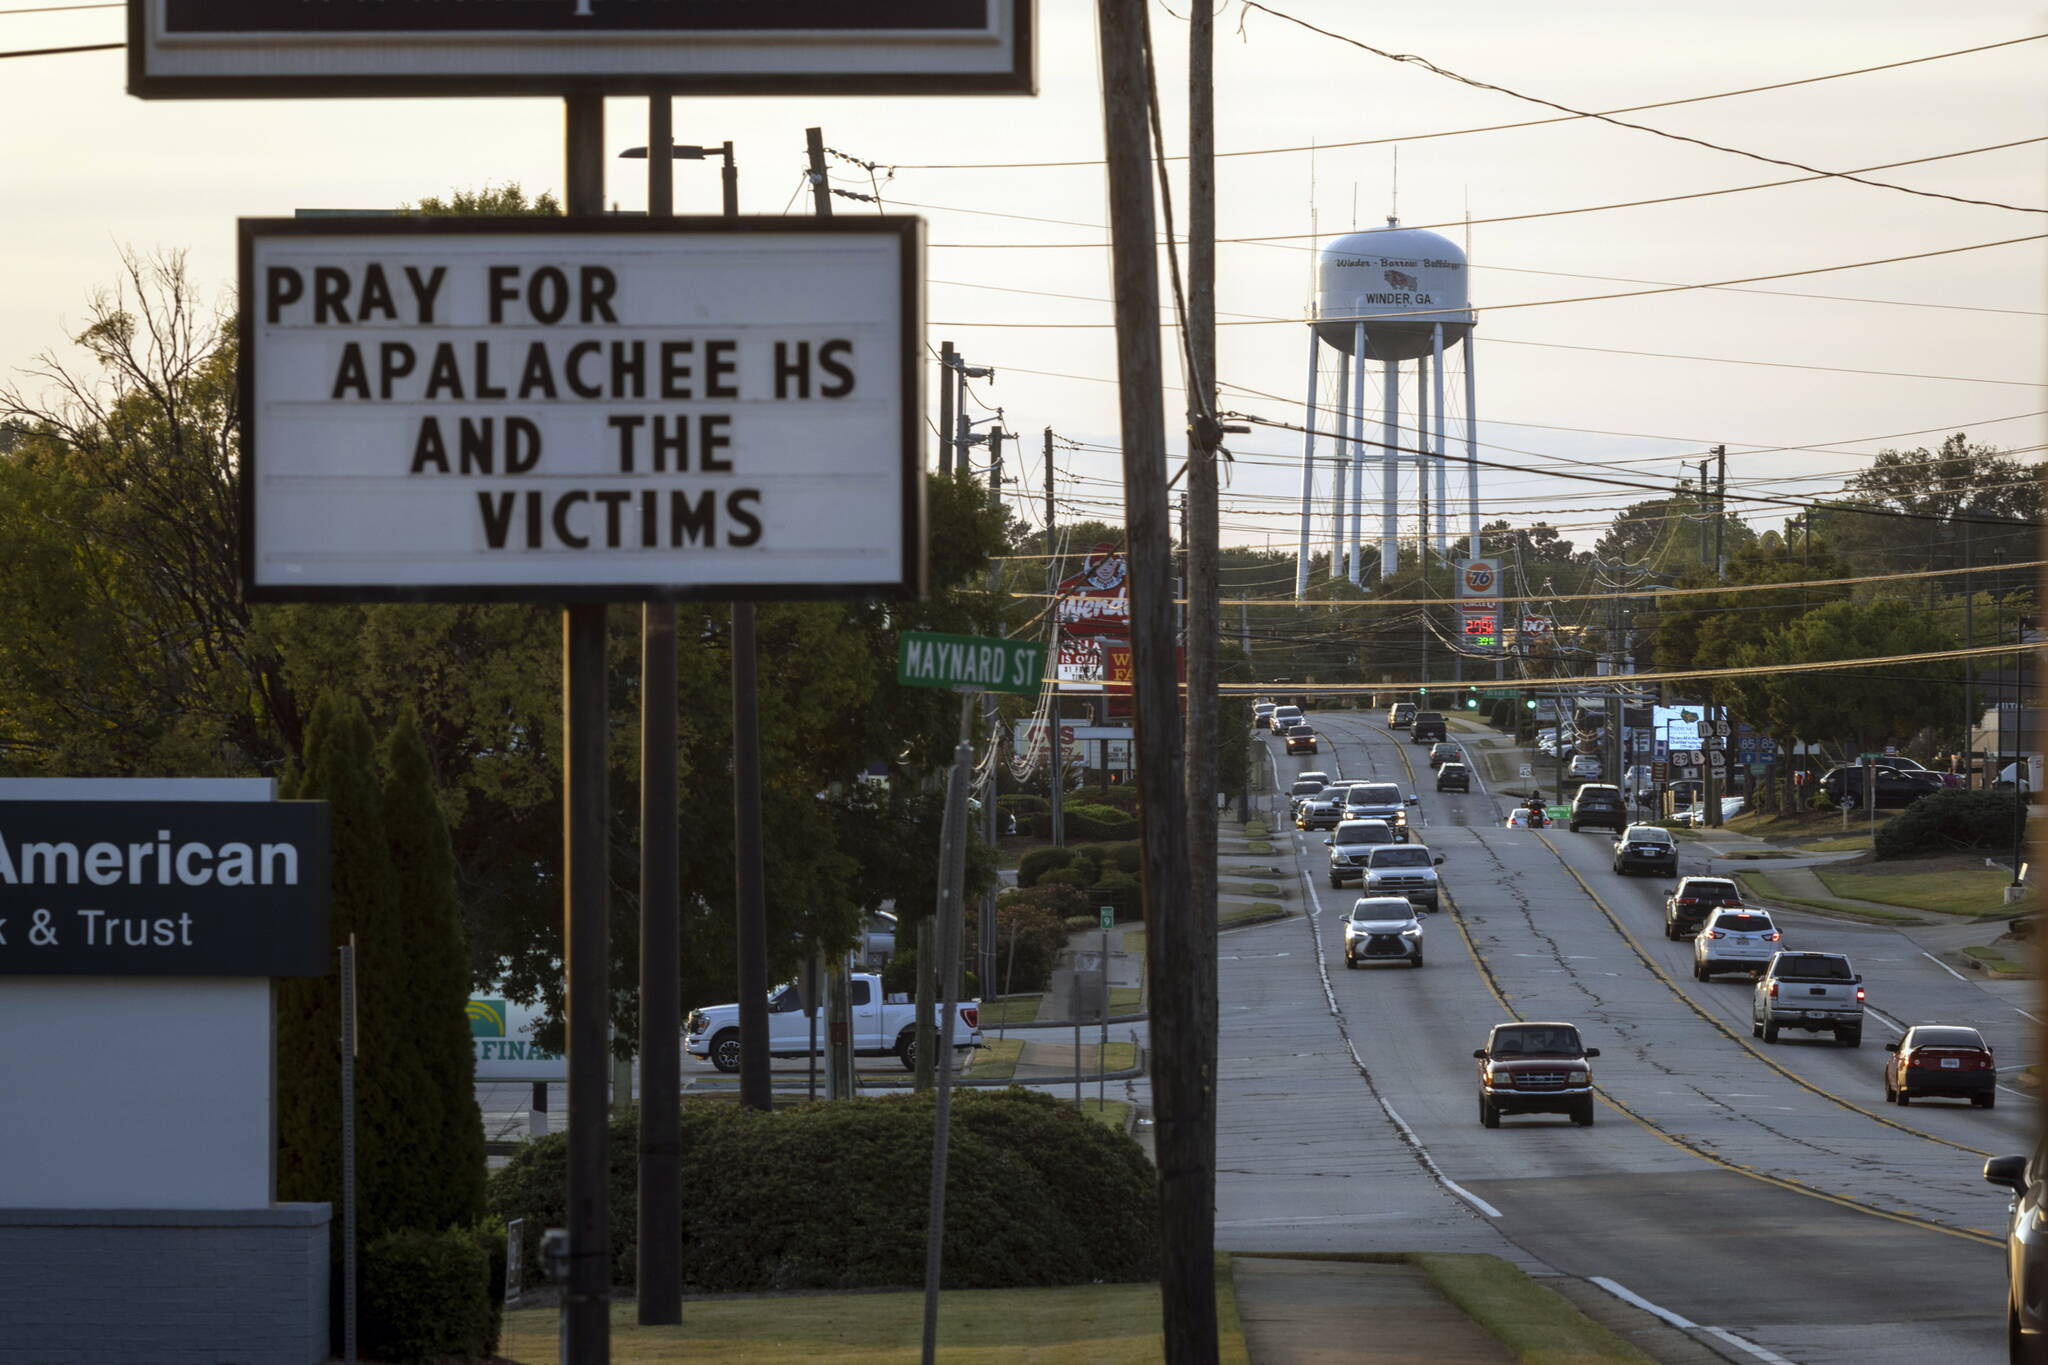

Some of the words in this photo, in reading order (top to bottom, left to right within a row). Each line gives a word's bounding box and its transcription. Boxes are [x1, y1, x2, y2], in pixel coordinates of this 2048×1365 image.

[265, 262, 448, 325] PRAY
[487, 264, 619, 325] FOR
[331, 339, 739, 400] APALACHEE
[772, 338, 856, 399] HS
[410, 415, 543, 475] AND
[607, 413, 733, 473] THE
[476, 489, 764, 550] VICTIMS
[1471, 570, 1490, 585] 76
[1058, 587, 1129, 617] Wend
[905, 639, 1006, 685] MAYNARD
[1012, 647, 1037, 687] ST
[1674, 754, 1687, 764] 29
[27, 908, 59, 947] &
[77, 909, 193, 947] Trust
